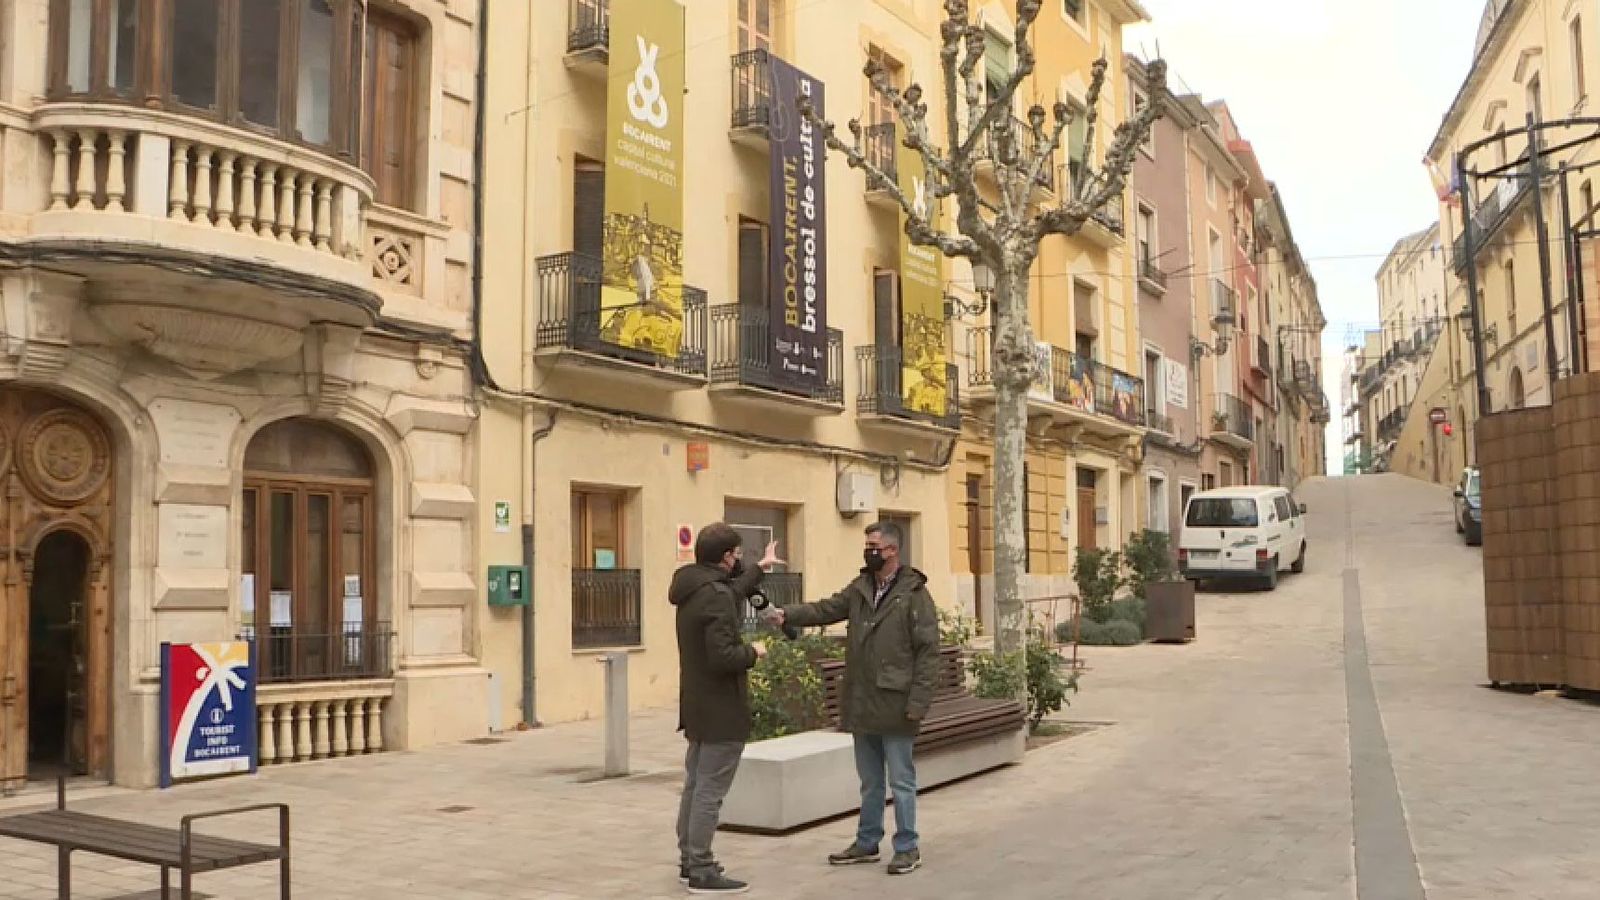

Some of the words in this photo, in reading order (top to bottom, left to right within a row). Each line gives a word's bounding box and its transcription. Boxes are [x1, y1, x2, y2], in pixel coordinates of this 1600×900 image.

[623, 121, 671, 152] BOCAIRENT
[799, 79, 815, 176] culta
[800, 187, 816, 220] de
[801, 228, 817, 333] bressol
[200, 725, 235, 736] TOURIST
[194, 745, 241, 757] BOCAIRENT
